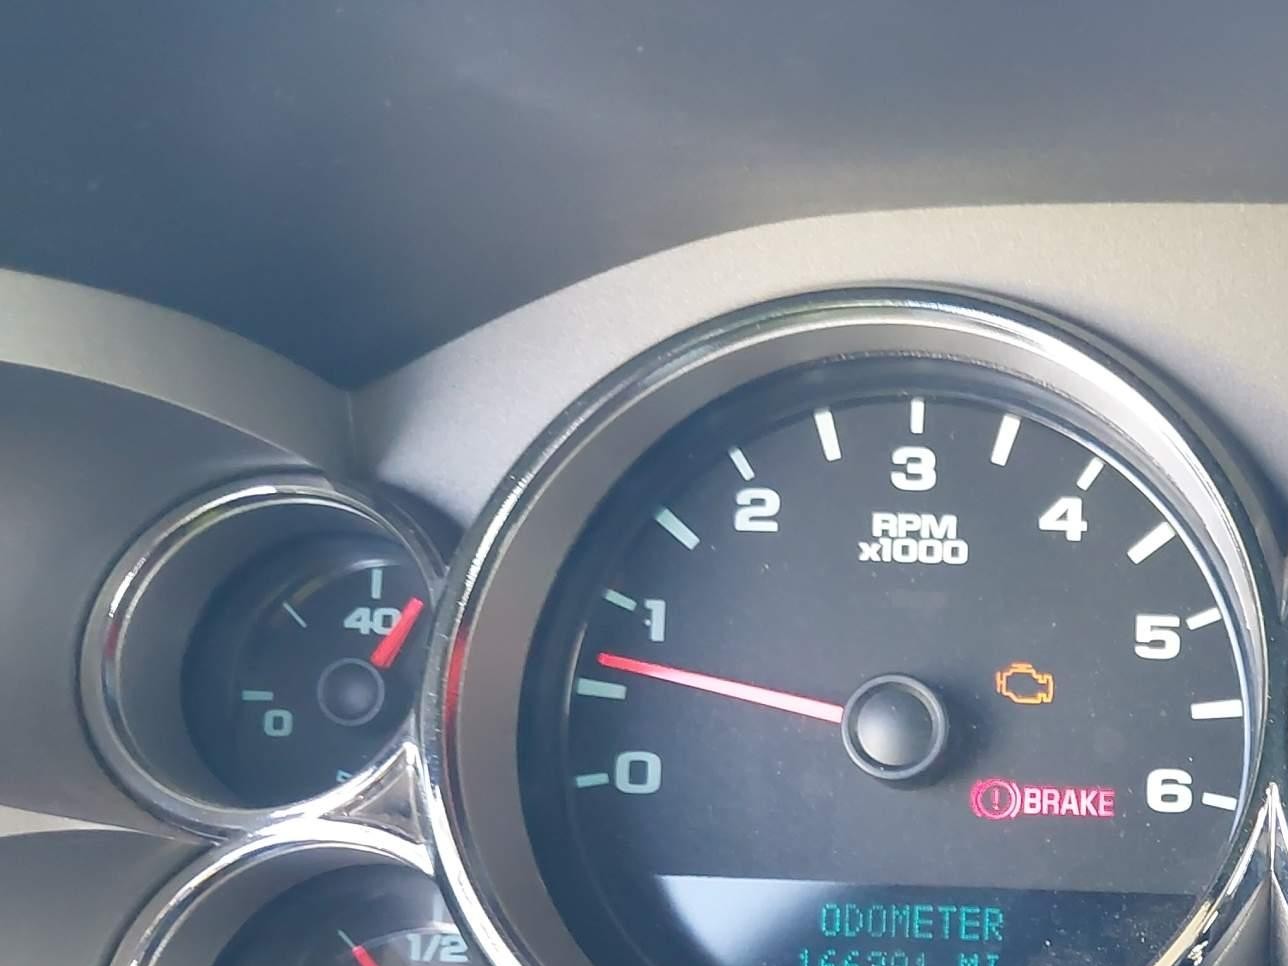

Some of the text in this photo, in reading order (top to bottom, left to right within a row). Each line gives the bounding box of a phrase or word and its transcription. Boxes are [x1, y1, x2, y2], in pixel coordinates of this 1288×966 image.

[890, 446, 936, 491] 3
[734, 489, 780, 533] 2
[871, 513, 957, 539] RPM
[1039, 497, 1087, 541] 4
[859, 538, 968, 565] x1000
[344, 607, 401, 634] 40
[644, 601, 666, 642] 1
[1134, 615, 1181, 660] 5
[263, 710, 292, 736] 0
[615, 752, 661, 795] 0
[1146, 770, 1192, 812] 6
[1023, 787, 1115, 817] BRAKE
[822, 904, 1003, 940] ODOMETER
[405, 933, 468, 962] 1/2
